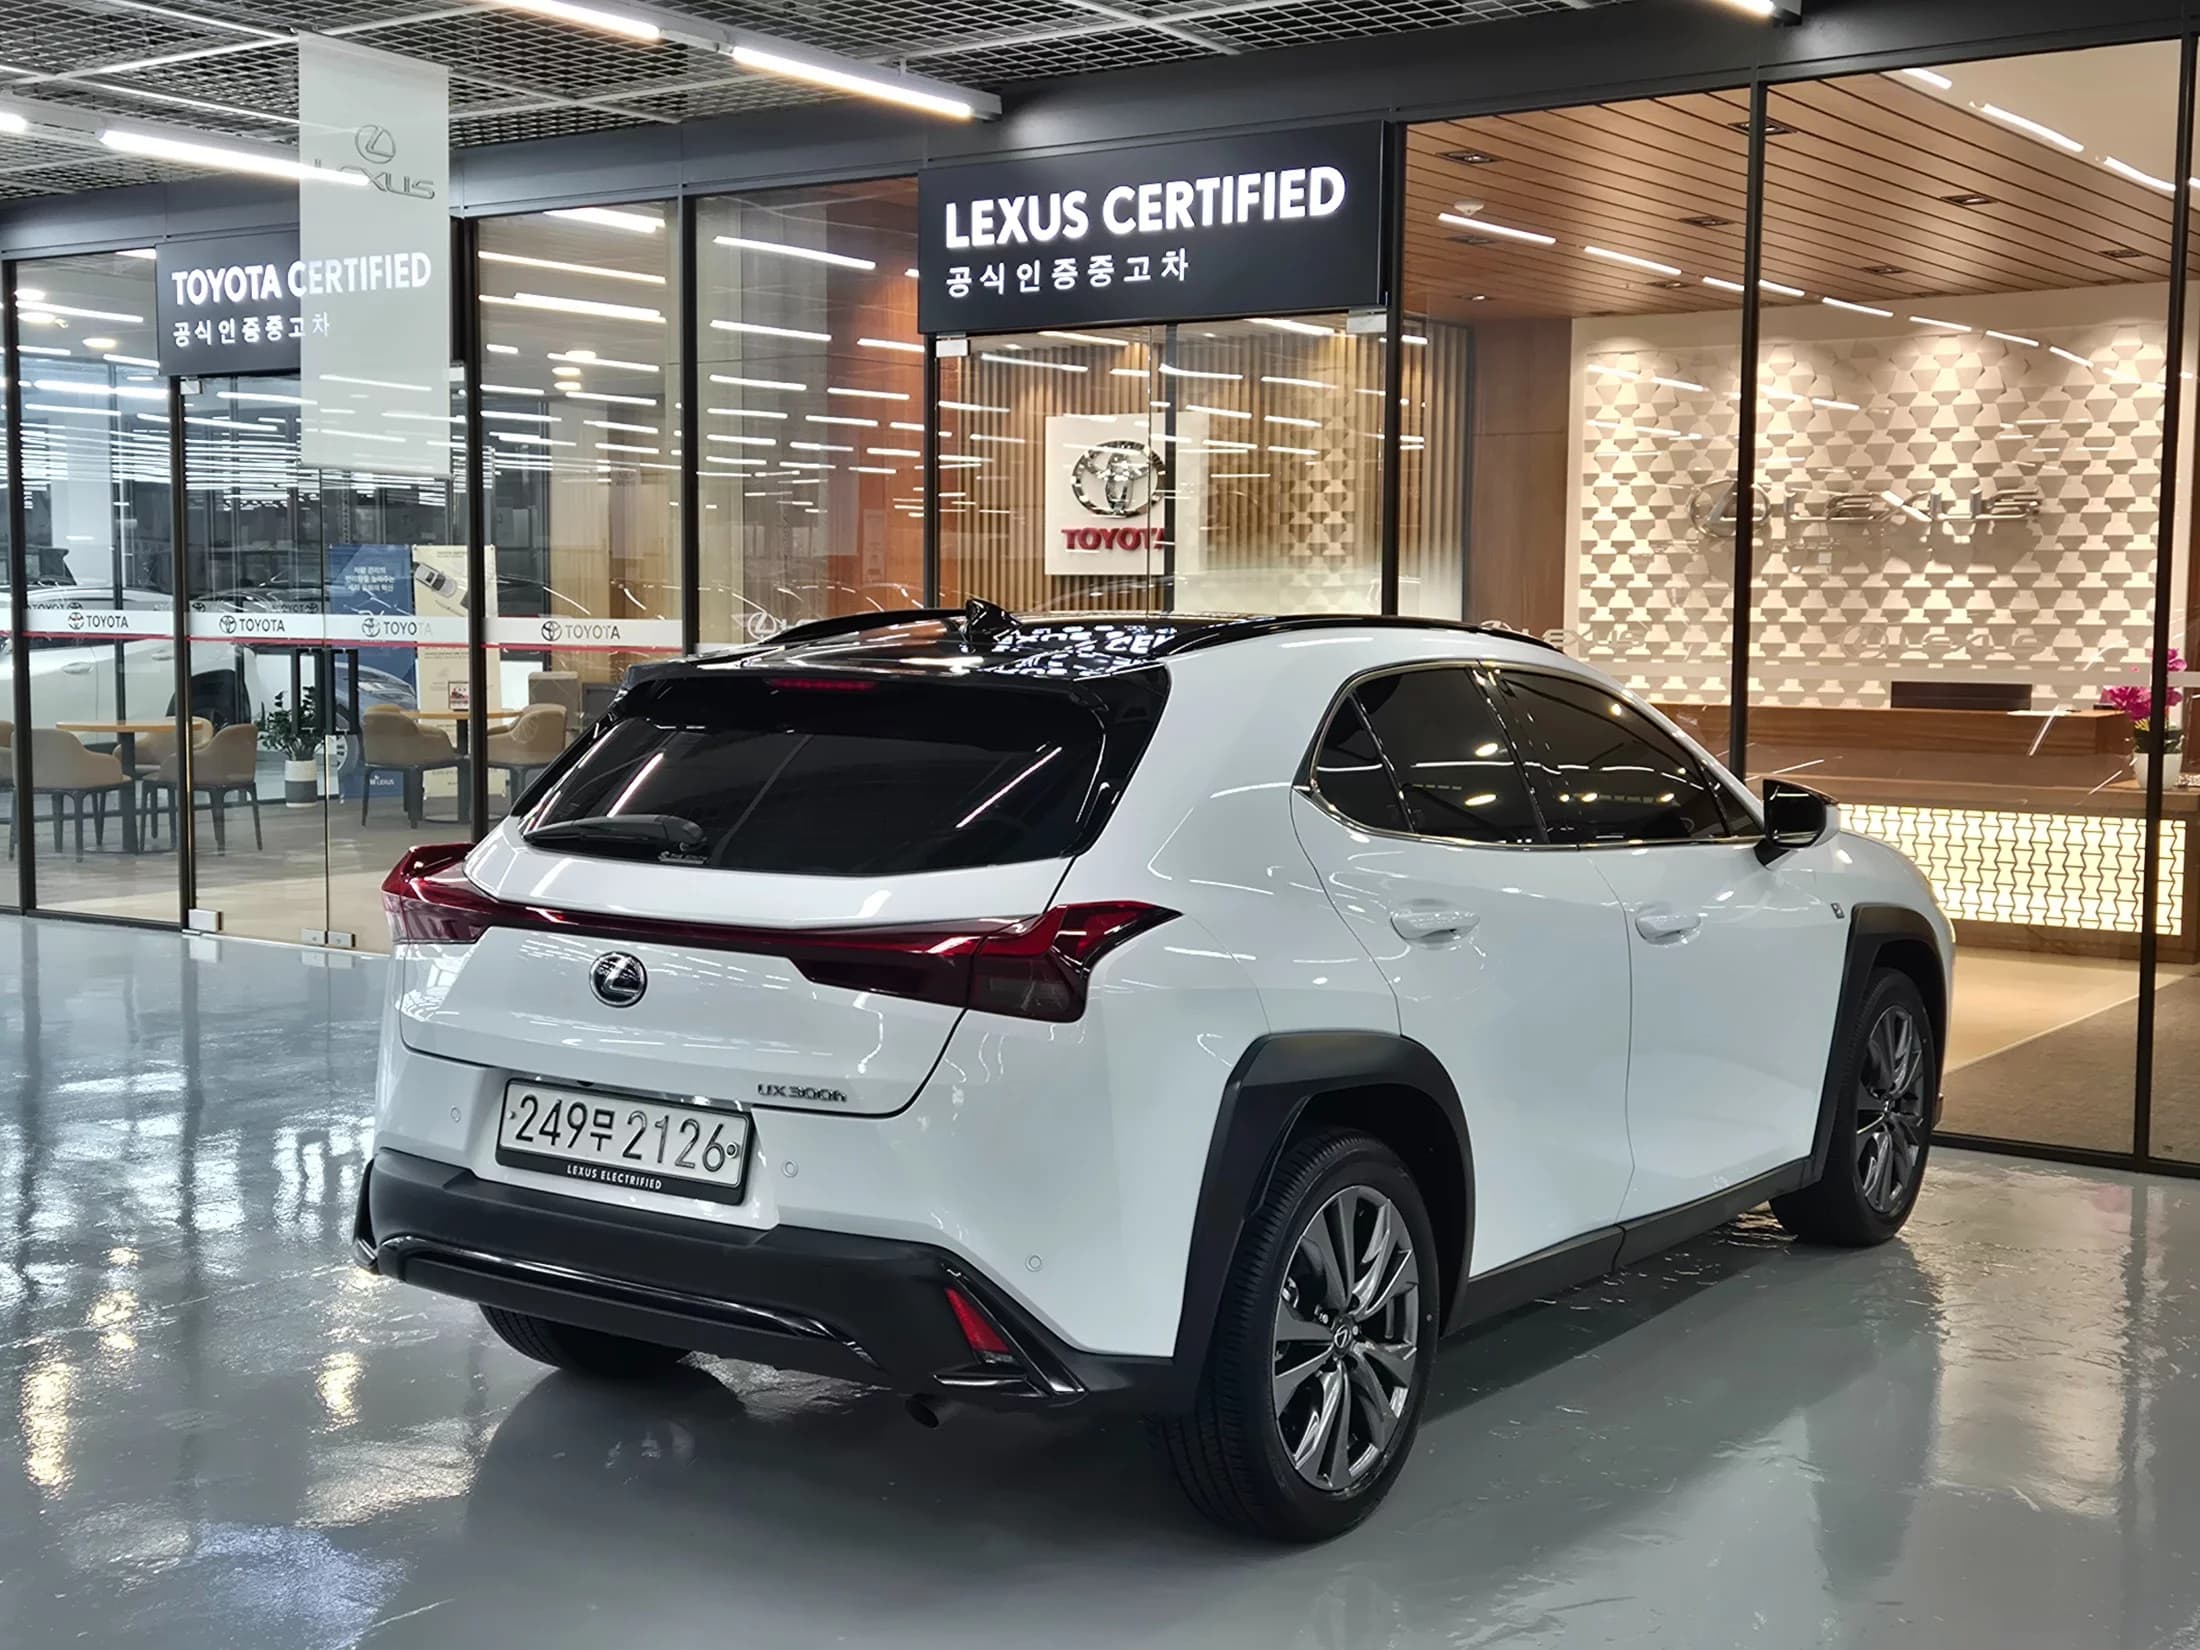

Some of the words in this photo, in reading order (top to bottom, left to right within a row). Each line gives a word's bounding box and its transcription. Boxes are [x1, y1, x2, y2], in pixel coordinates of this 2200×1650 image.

[945, 189, 1090, 249] LEXUS
[1102, 165, 1347, 235] CERTIFIED
[171, 263, 283, 306] TOYOTA
[287, 251, 432, 299] CERTIFIED
[945, 247, 1189, 298] 공식인증중고차
[172, 311, 330, 348] 공식인증중고차
[87, 615, 129, 628] TOYOTA
[239, 618, 286, 632] TOYOTA
[384, 621, 432, 636] TOYOTA
[565, 624, 621, 640] TOYOTA
[566, 1164, 598, 1179] LEXUS
[599, 1168, 663, 1190] ELECTRIFIED
